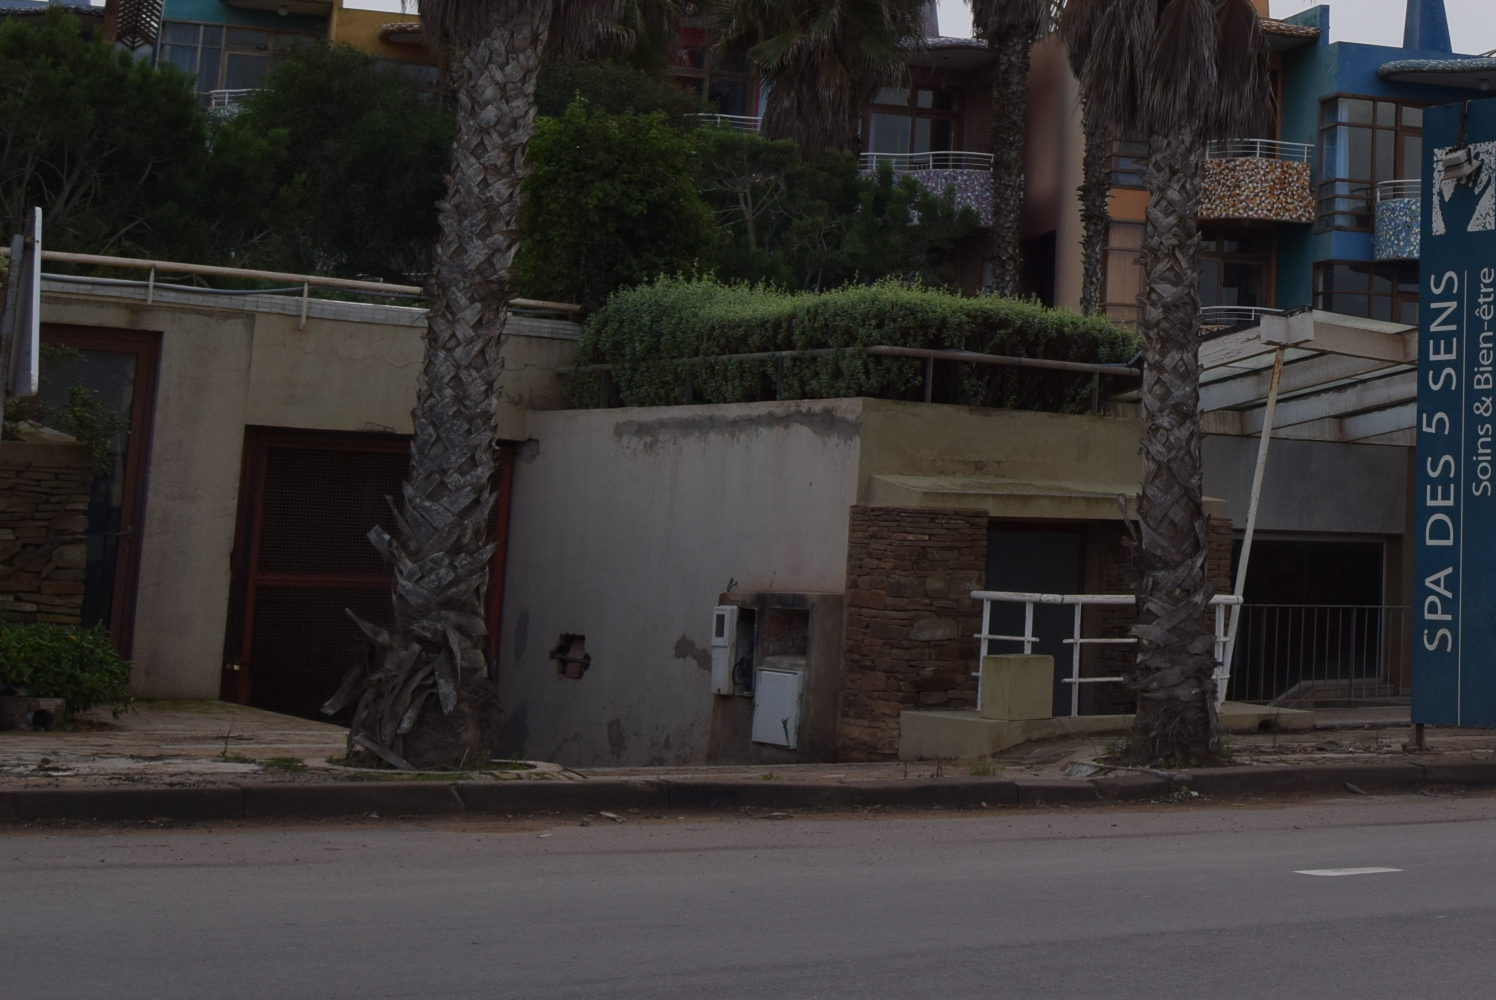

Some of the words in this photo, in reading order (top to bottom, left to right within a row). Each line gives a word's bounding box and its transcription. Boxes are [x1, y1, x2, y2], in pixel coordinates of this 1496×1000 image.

[1428, 270, 1458, 391] SENS
[1473, 267, 1495, 390] Bien-être
[1422, 411, 1450, 435] 5
[1473, 396, 1493, 417] &
[1425, 454, 1455, 546] DES
[1472, 423, 1492, 496] Soins
[1423, 567, 1453, 652] SPA
